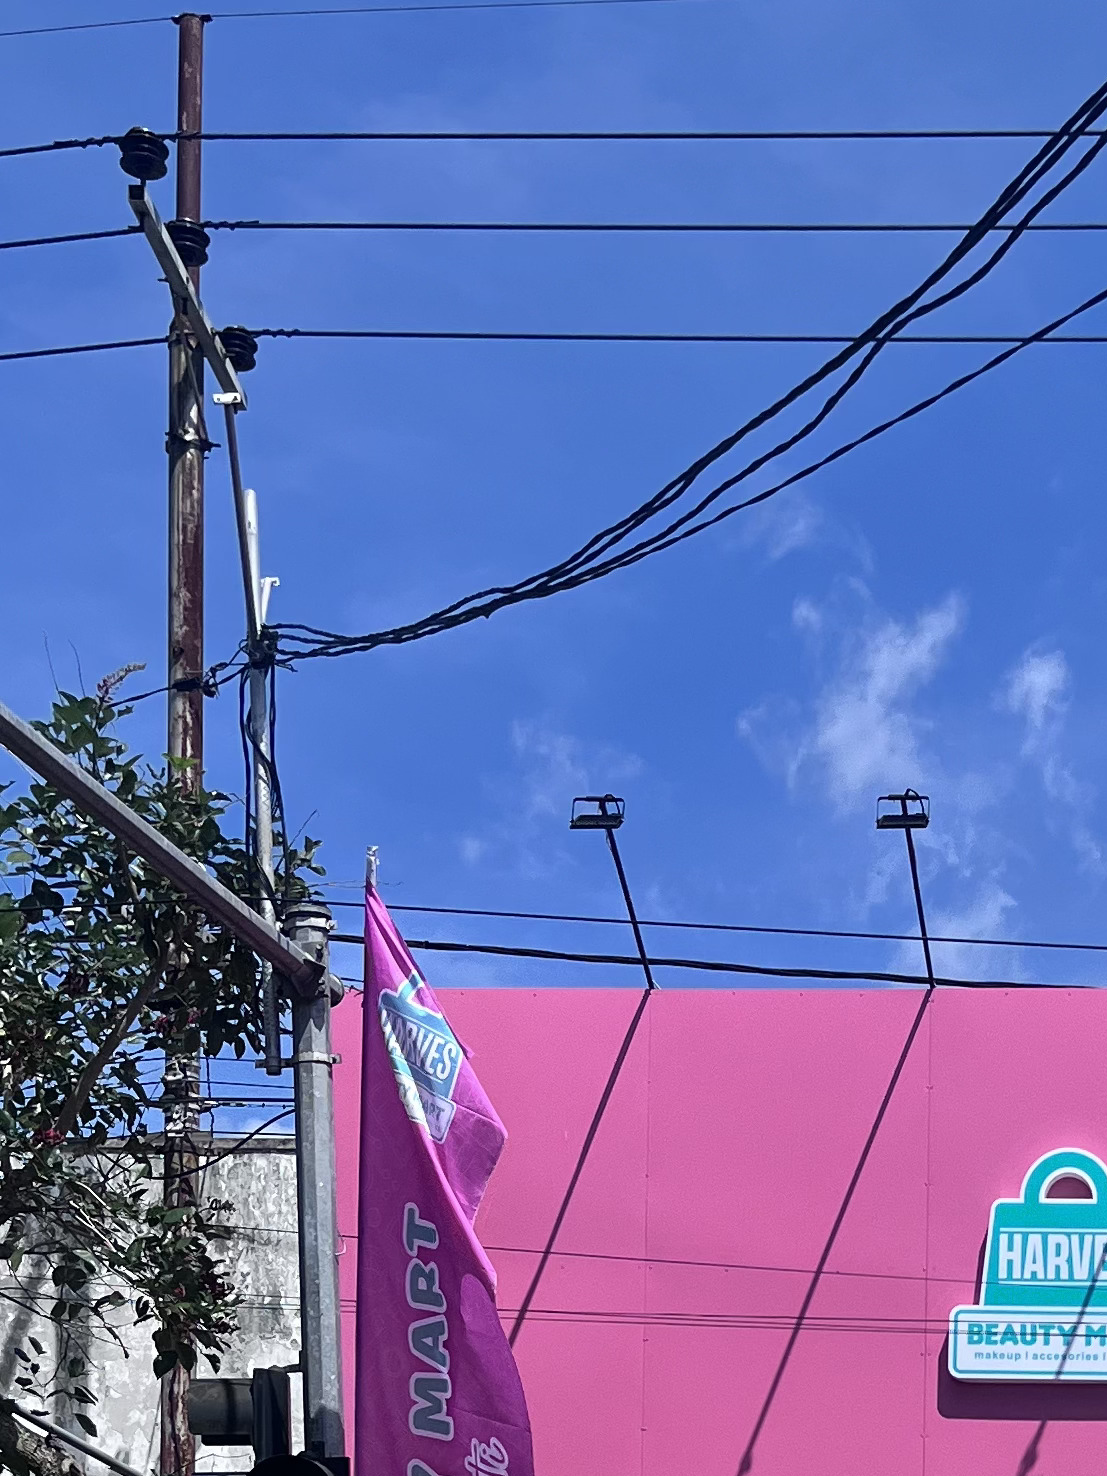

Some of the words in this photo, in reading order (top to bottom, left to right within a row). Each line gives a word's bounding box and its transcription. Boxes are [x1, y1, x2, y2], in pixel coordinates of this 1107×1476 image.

[403, 1201, 454, 1441] MART
[967, 1323, 1077, 1347] BEAUTY
[974, 1351, 1021, 1361] makeup
